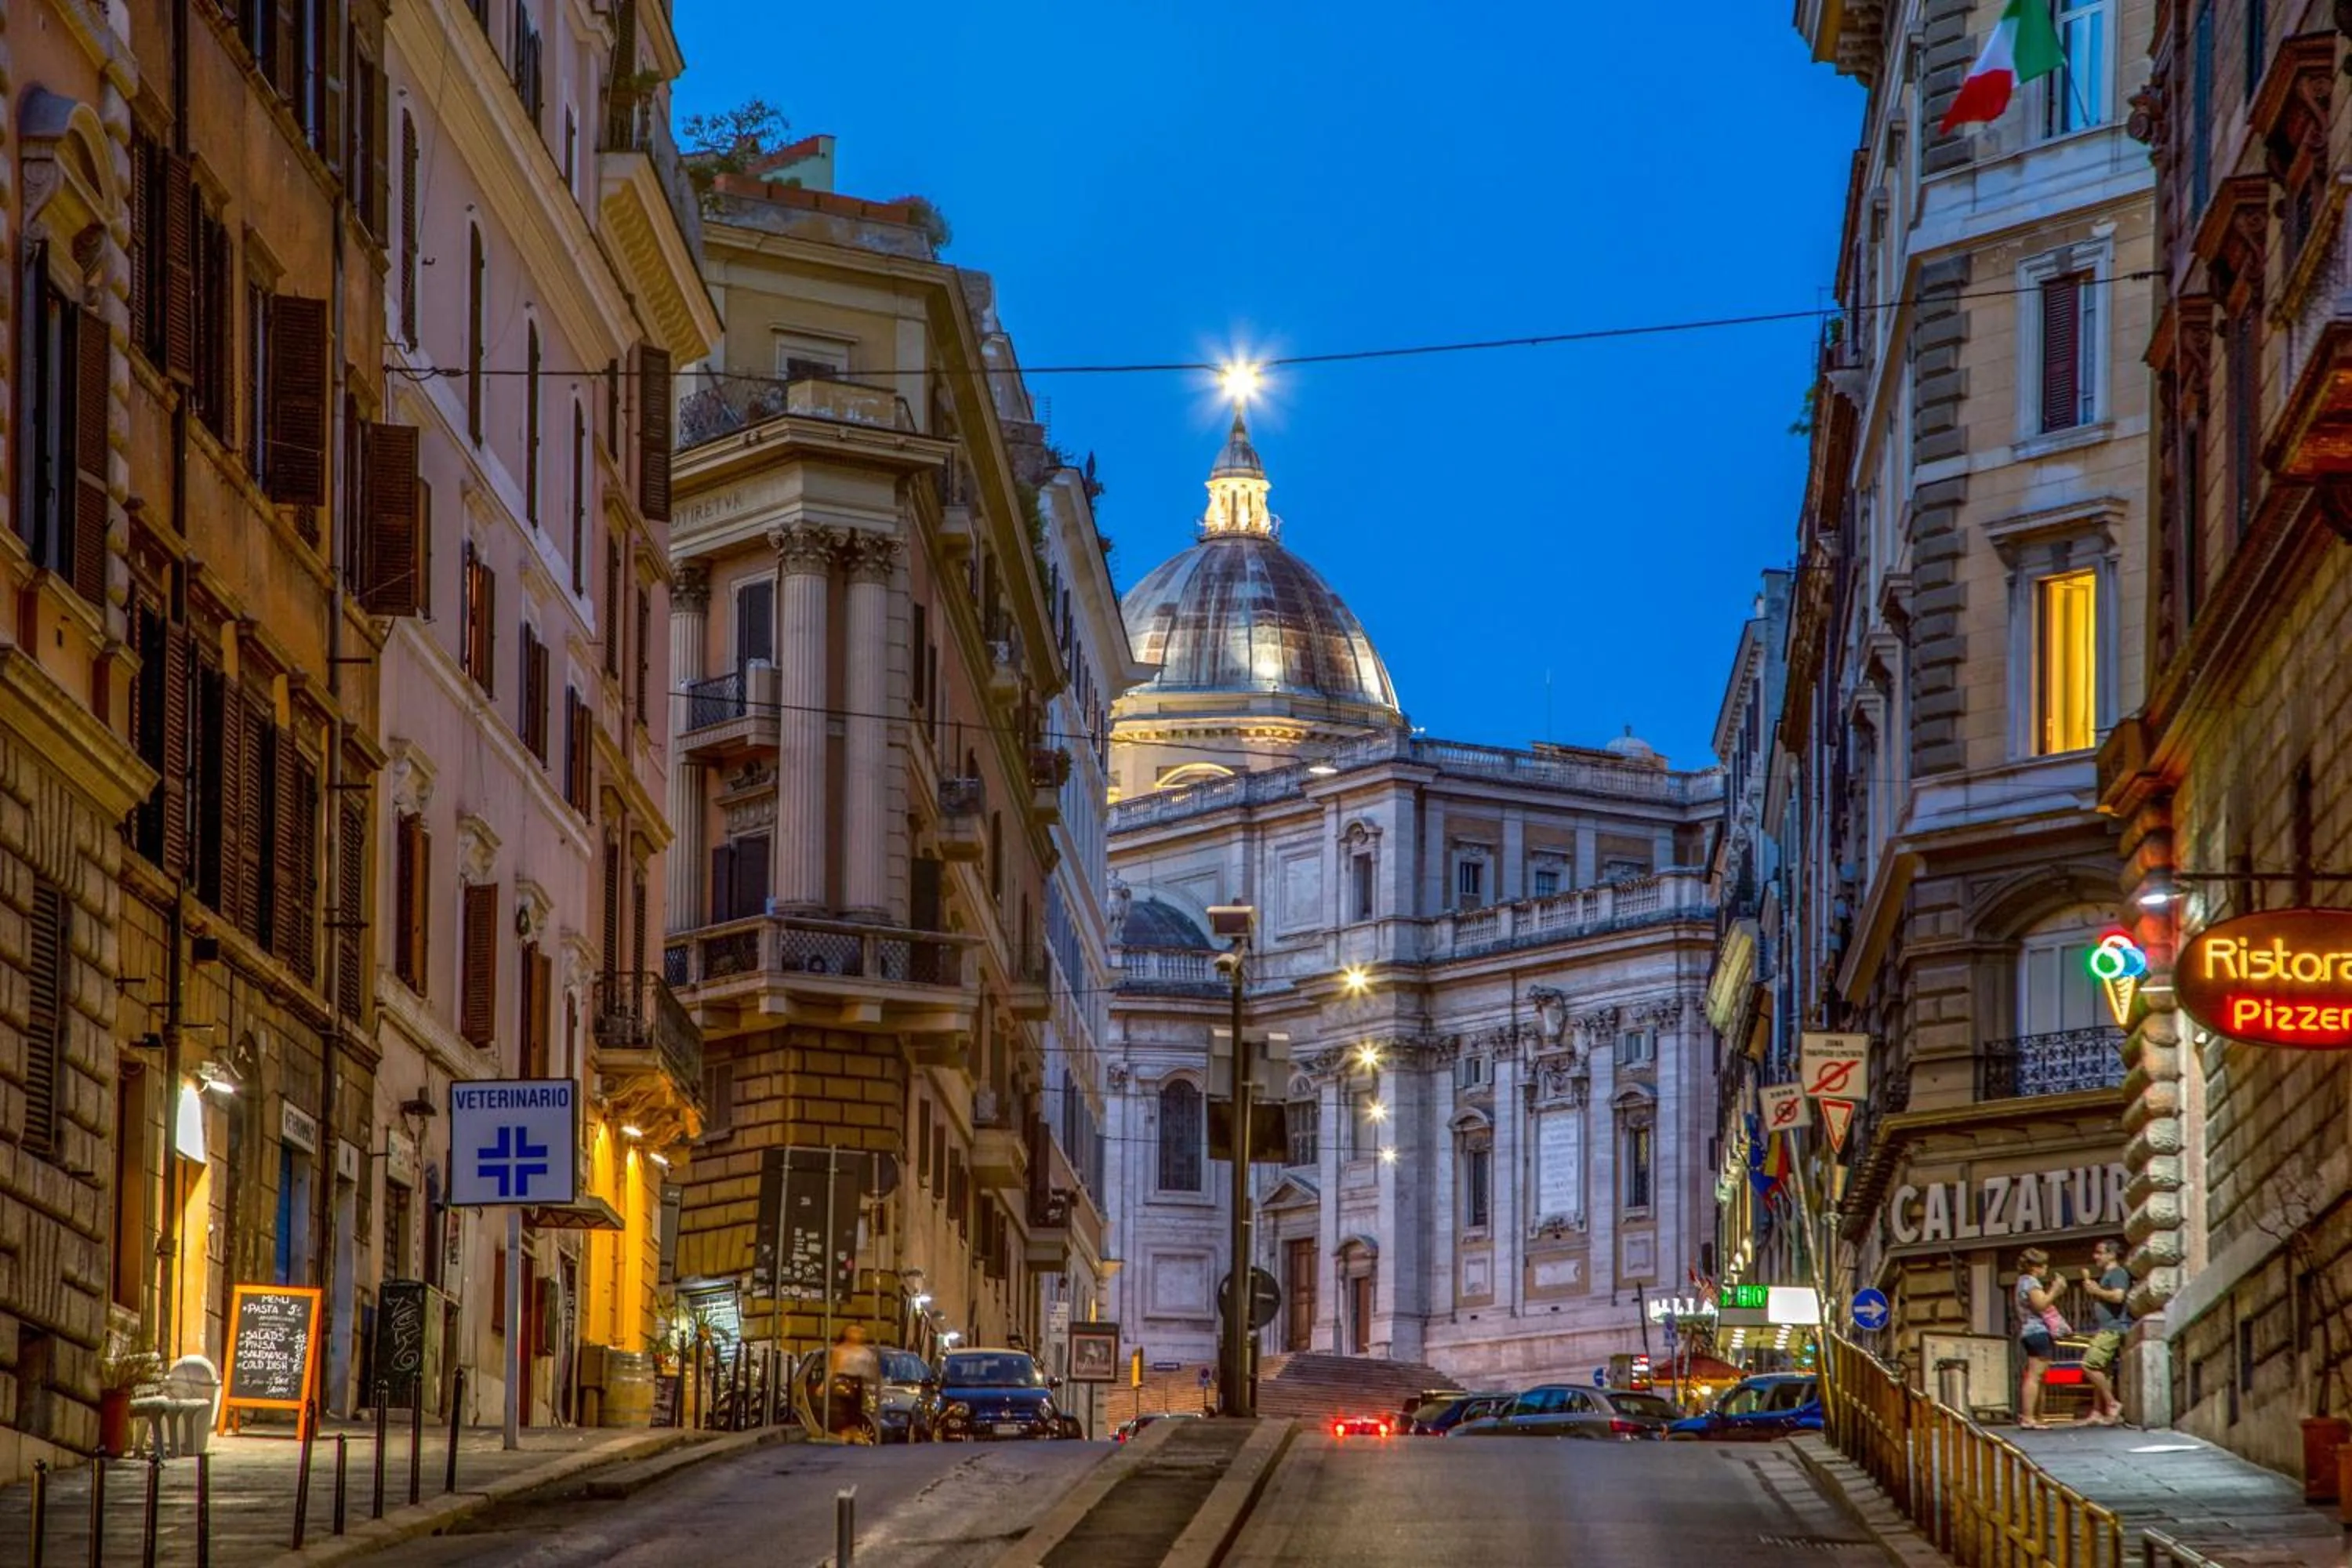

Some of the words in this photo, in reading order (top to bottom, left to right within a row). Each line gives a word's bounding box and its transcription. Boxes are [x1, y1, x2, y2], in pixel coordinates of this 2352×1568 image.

[456, 1087, 569, 1110] VETERINARIO
[1891, 1163, 2132, 1243] CALZATUR
[261, 1294, 289, 1304] MENU
[247, 1302, 279, 1315] PASTA
[245, 1330, 285, 1341] SALADS
[241, 1359, 265, 1370] COLD
